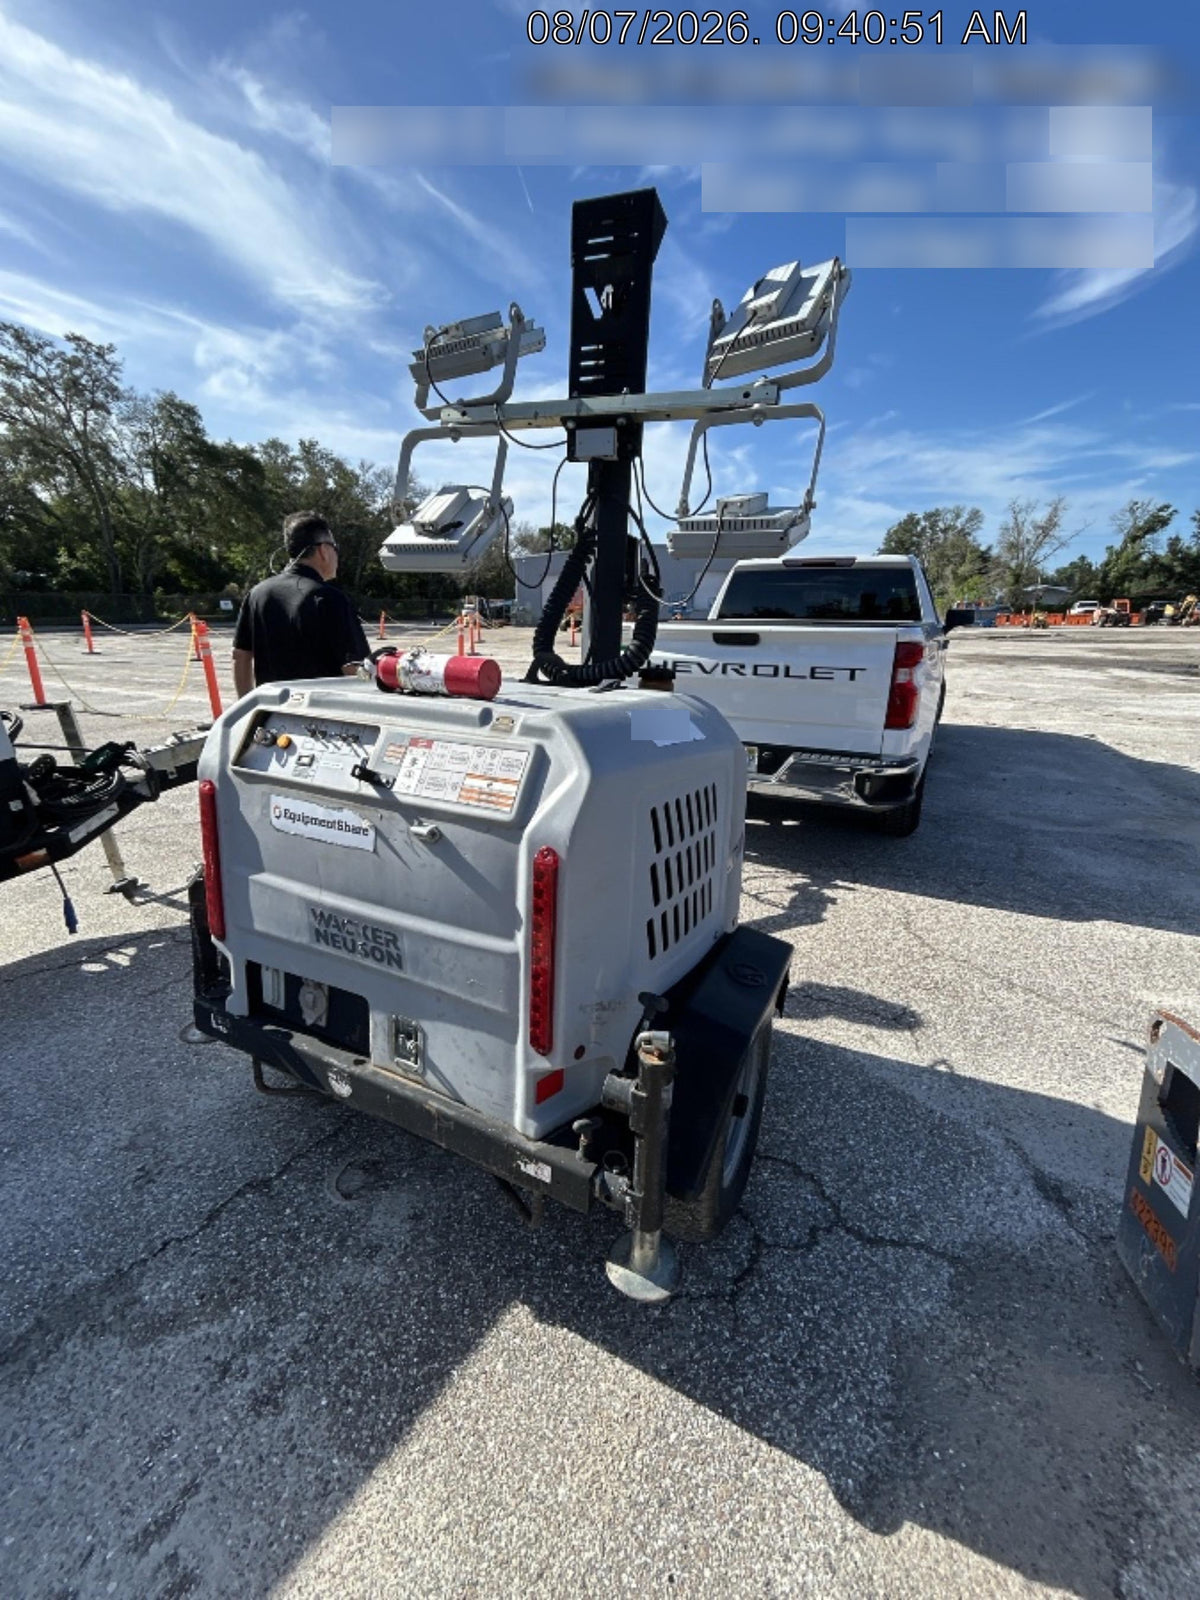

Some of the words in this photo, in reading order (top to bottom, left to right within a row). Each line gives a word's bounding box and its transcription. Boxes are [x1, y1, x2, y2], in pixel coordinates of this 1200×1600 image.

[646, 659, 867, 682] HEVROLET
[283, 808, 369, 837] EquipmentShare
[314, 927, 404, 970] NEUSON
